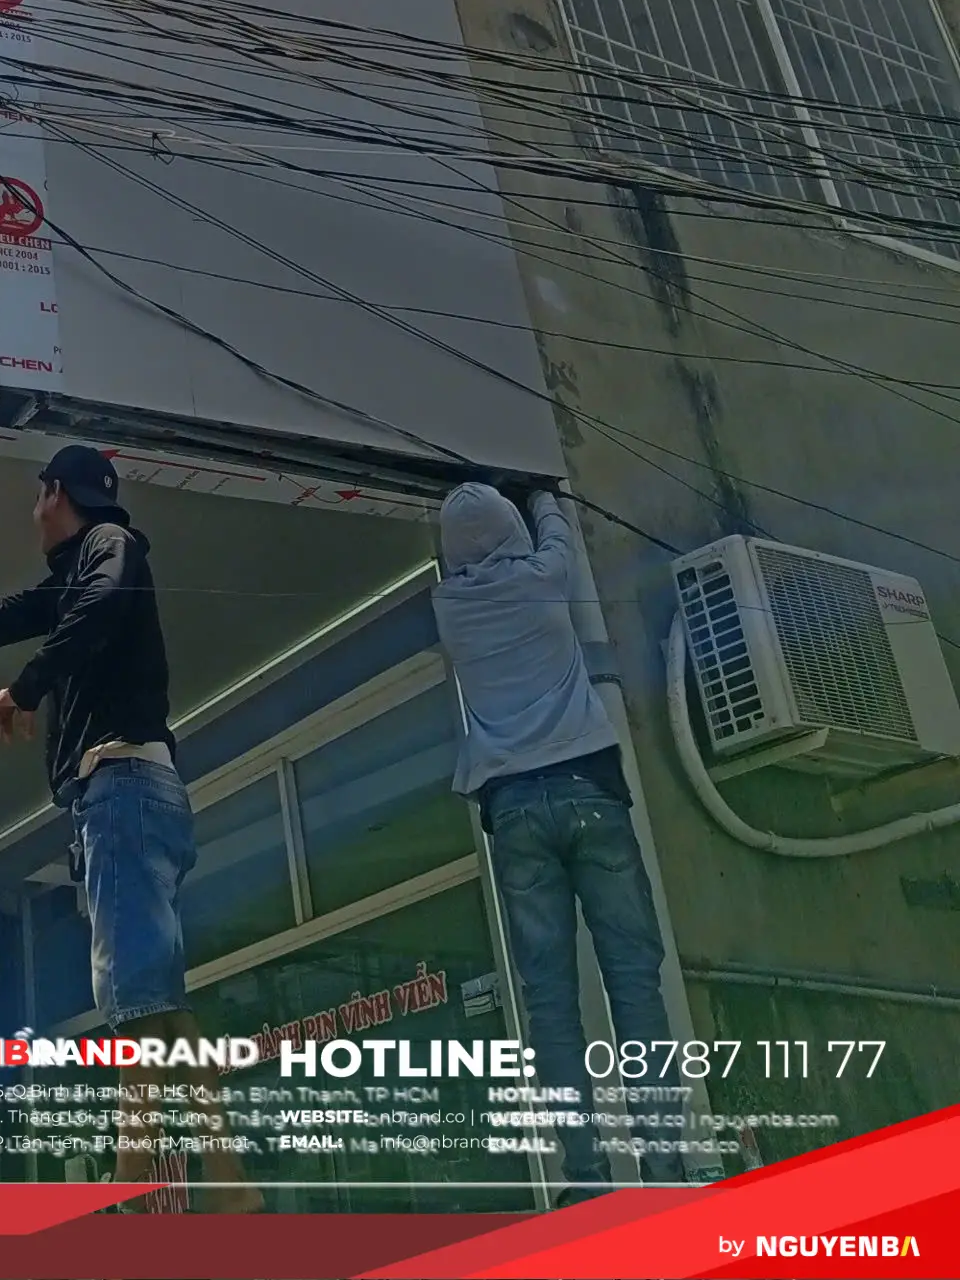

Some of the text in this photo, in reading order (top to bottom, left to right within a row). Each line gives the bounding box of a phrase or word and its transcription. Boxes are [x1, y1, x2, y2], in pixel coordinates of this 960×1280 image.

[18, 237, 50, 250] CHEN
[16, 249, 39, 261] 2004
[0, 356, 53, 373] CHEN
[876, 585, 925, 607] SHARP
[303, 1007, 338, 1045] PIN
